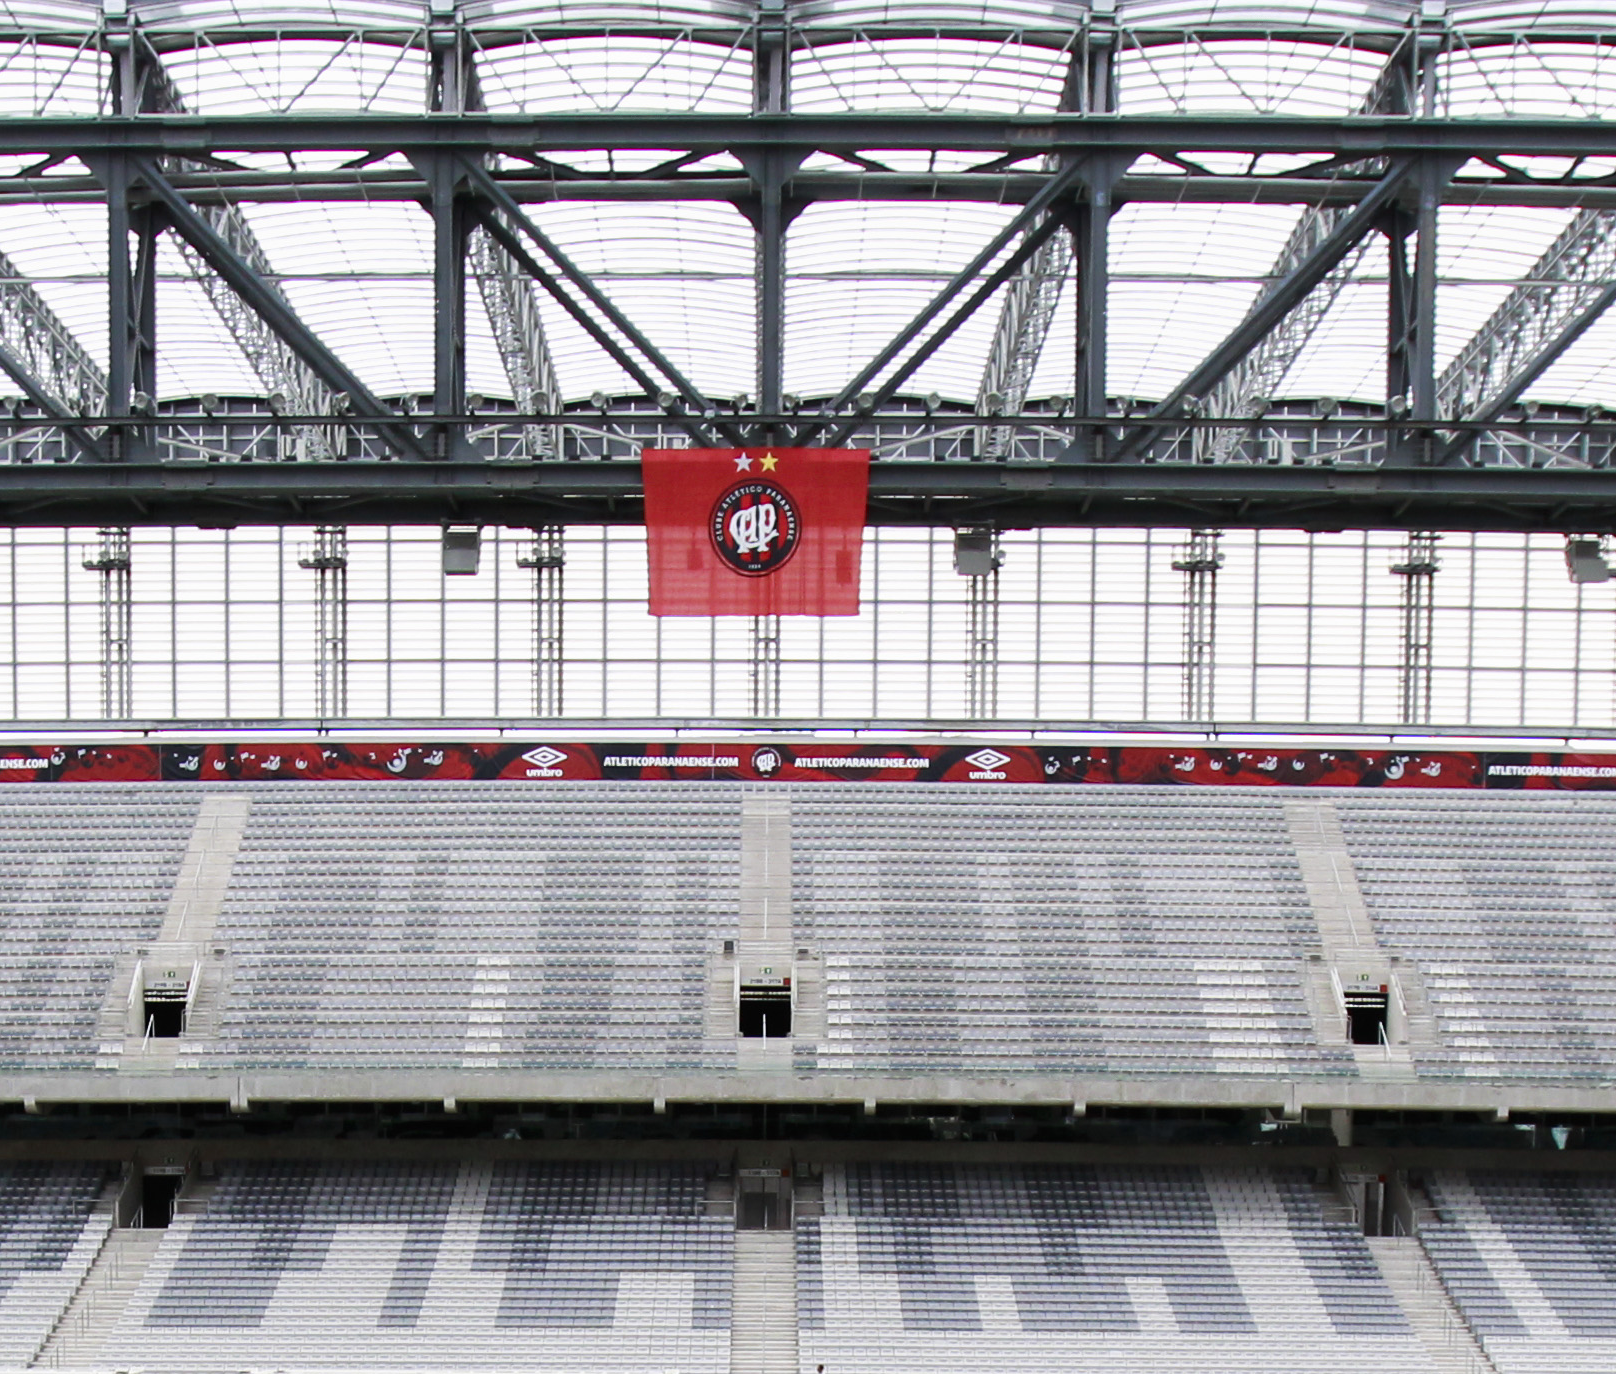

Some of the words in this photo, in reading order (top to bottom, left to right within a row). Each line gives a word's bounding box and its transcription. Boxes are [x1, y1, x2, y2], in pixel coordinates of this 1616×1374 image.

[603, 755, 740, 769] ATLETICOPARANAENSE.COM
[794, 755, 930, 769] ATLETICOPARANAENSE.COM
[526, 767, 563, 779] umbro
[969, 770, 1006, 781] umbro
